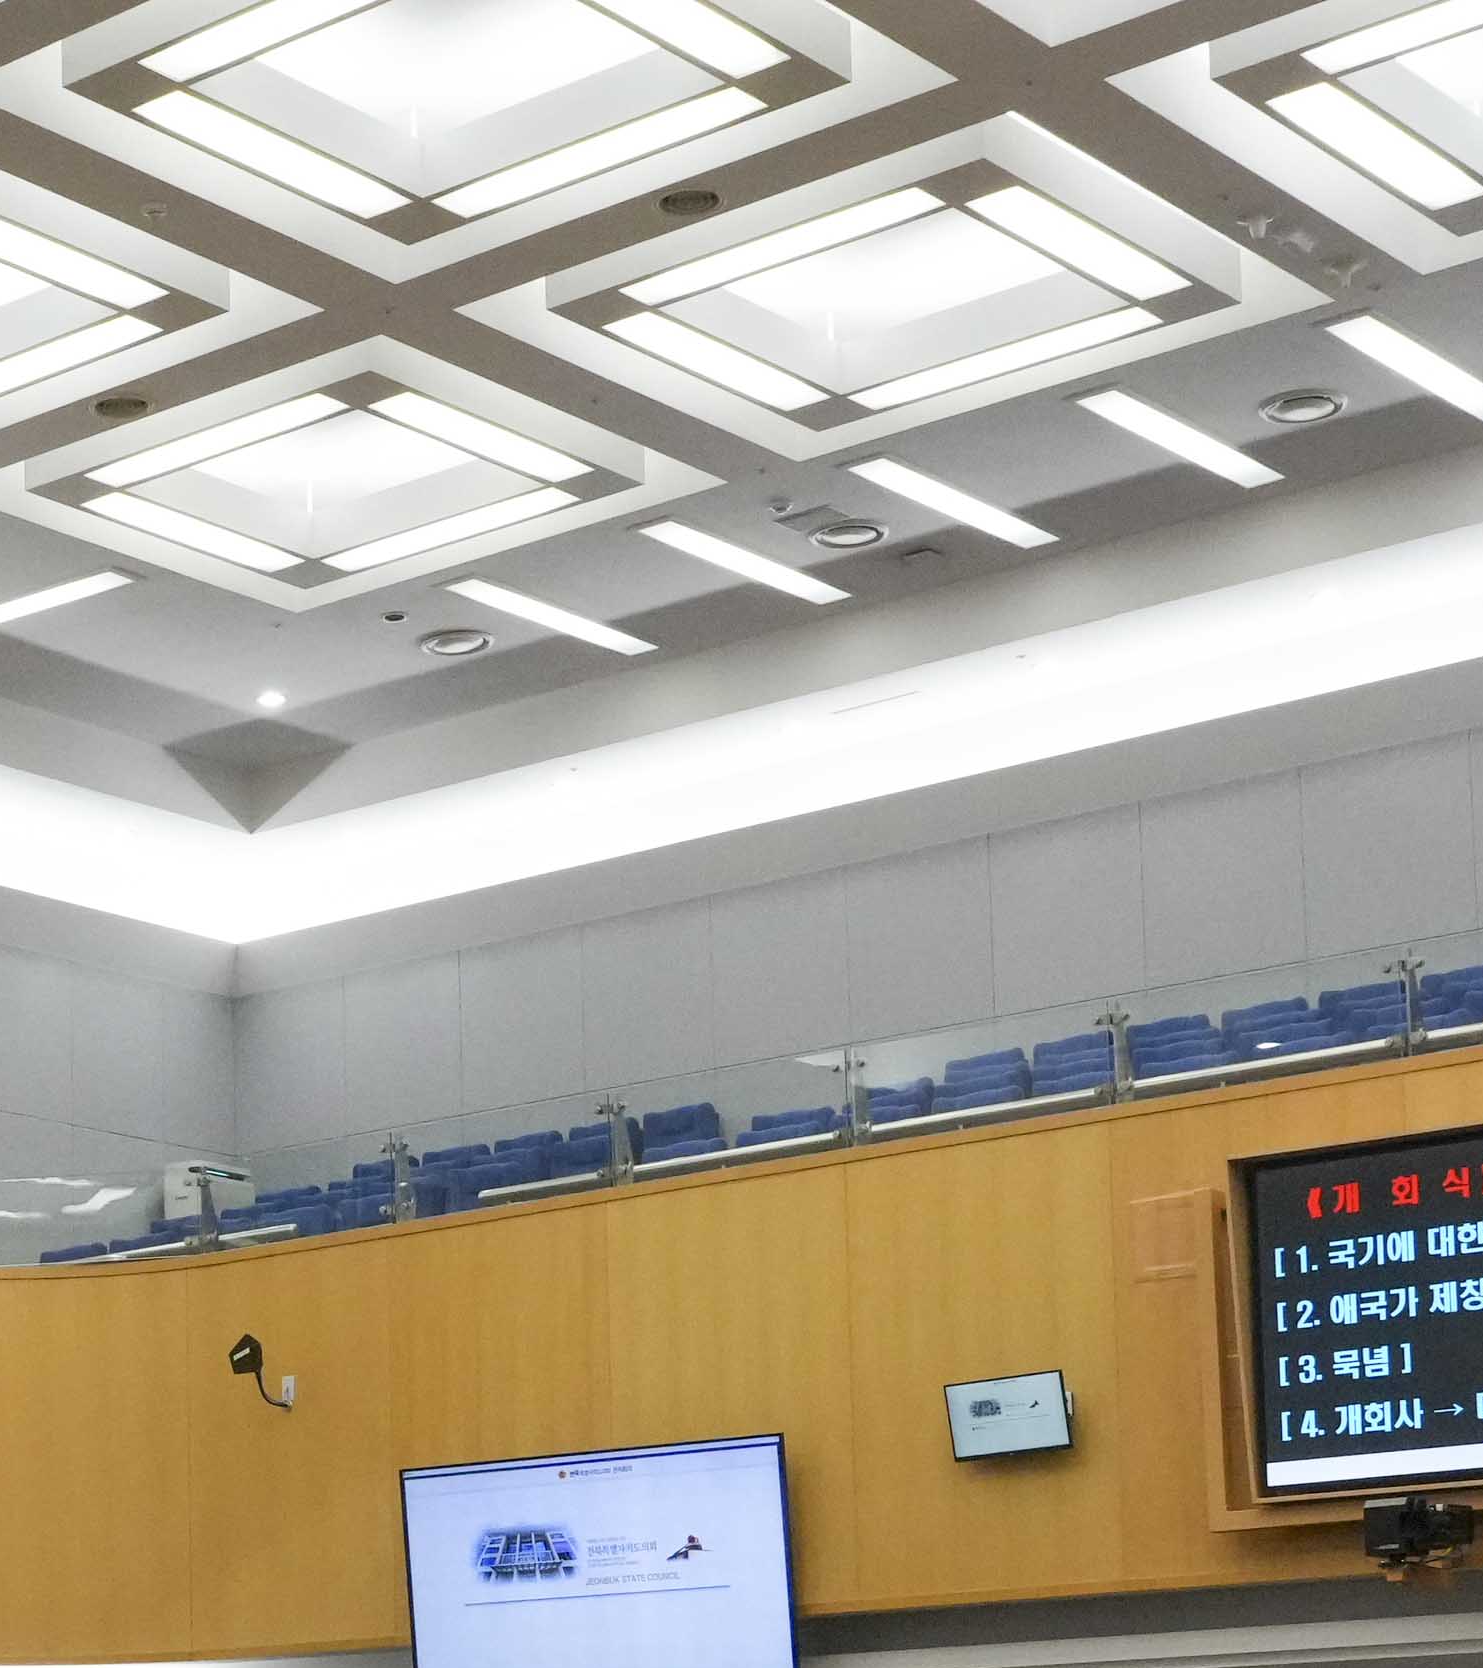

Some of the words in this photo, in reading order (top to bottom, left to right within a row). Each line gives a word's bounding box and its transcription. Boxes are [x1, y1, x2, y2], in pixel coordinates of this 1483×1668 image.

[1296, 1245, 1319, 1273] 1.
[1328, 1230, 1415, 1270] 국기에
[1296, 1299, 1321, 1329] 2.
[1330, 1286, 1419, 1325] 애국가
[1298, 1355, 1323, 1384] 3.
[1332, 1344, 1390, 1380] 묵념
[1300, 1410, 1325, 1438] 4.
[1334, 1398, 1425, 1436] 개회사
